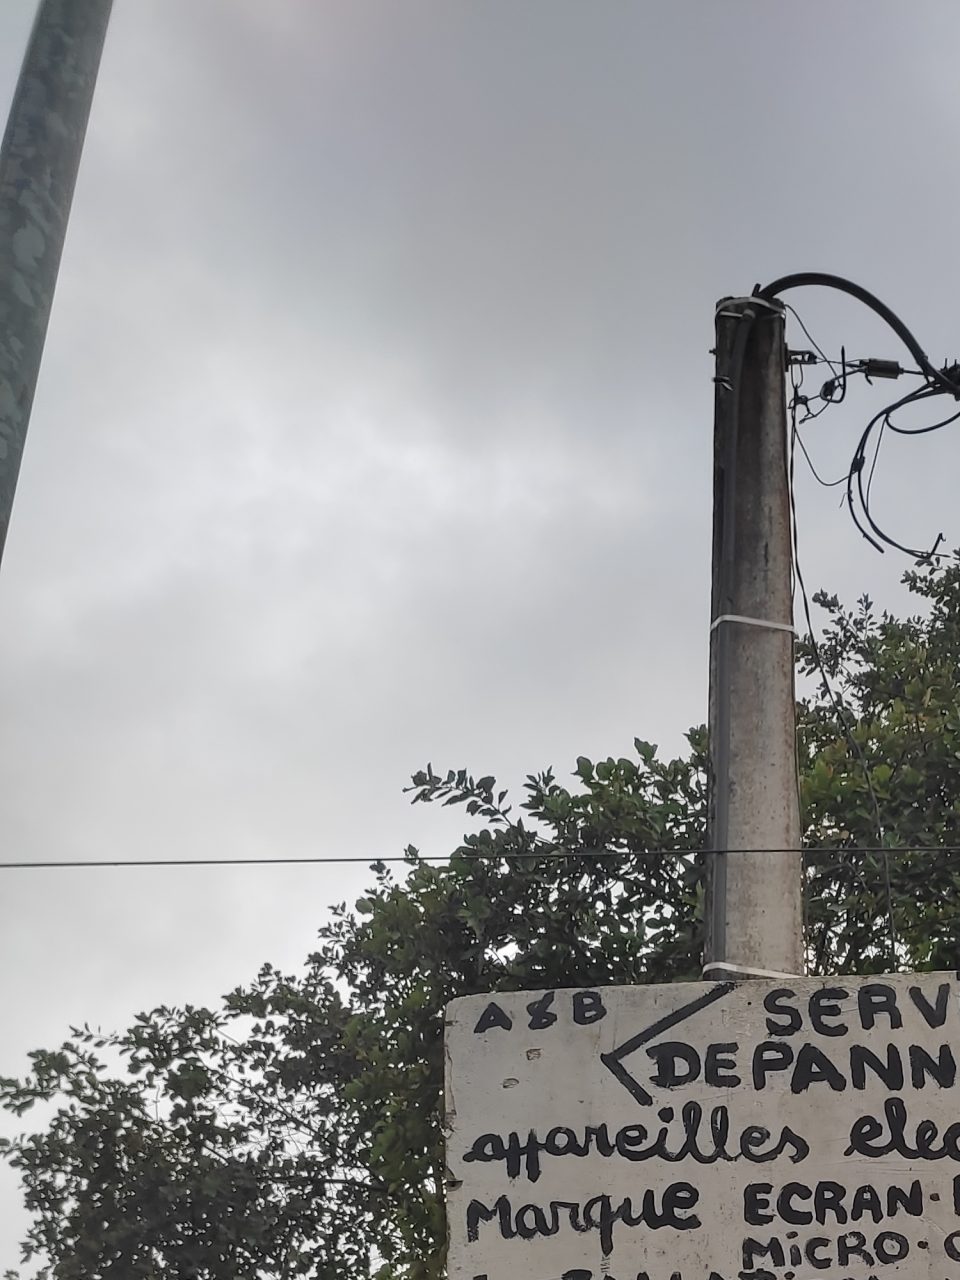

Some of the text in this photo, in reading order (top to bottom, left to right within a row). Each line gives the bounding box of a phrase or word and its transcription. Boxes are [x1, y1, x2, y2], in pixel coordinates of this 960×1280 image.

[473, 1001, 513, 1033] A
[572, 990, 607, 1025] B
[463, 1100, 810, 1183] appareilles
[467, 1181, 702, 1257] Marque
